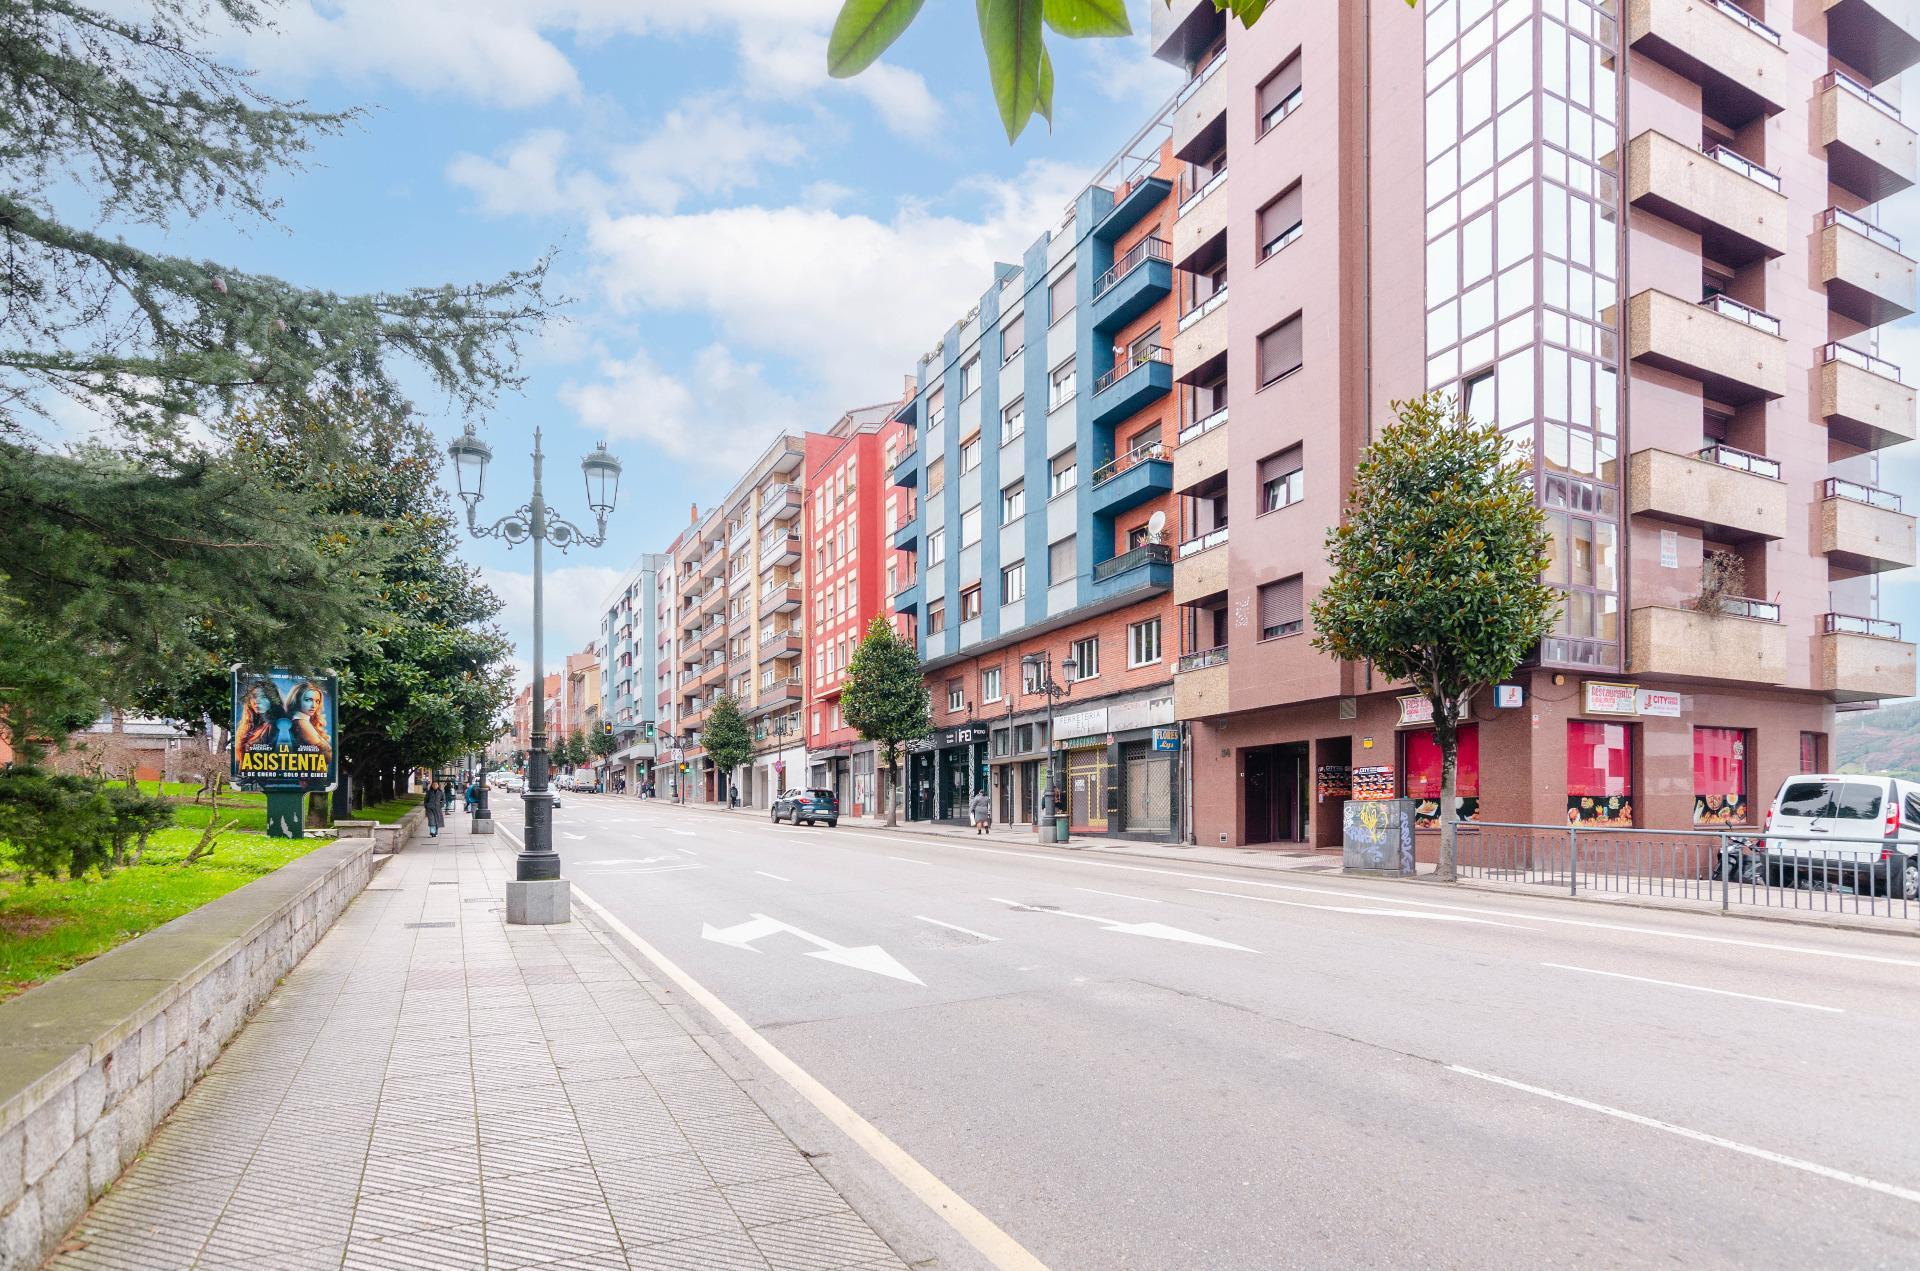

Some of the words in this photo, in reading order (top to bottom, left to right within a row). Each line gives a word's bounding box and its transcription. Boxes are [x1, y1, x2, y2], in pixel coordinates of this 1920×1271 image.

[1653, 695, 1667, 705] CITY
[1156, 730, 1179, 740] FLORES
[279, 744, 289, 753] LA
[241, 752, 328, 771] ASISTENTA
